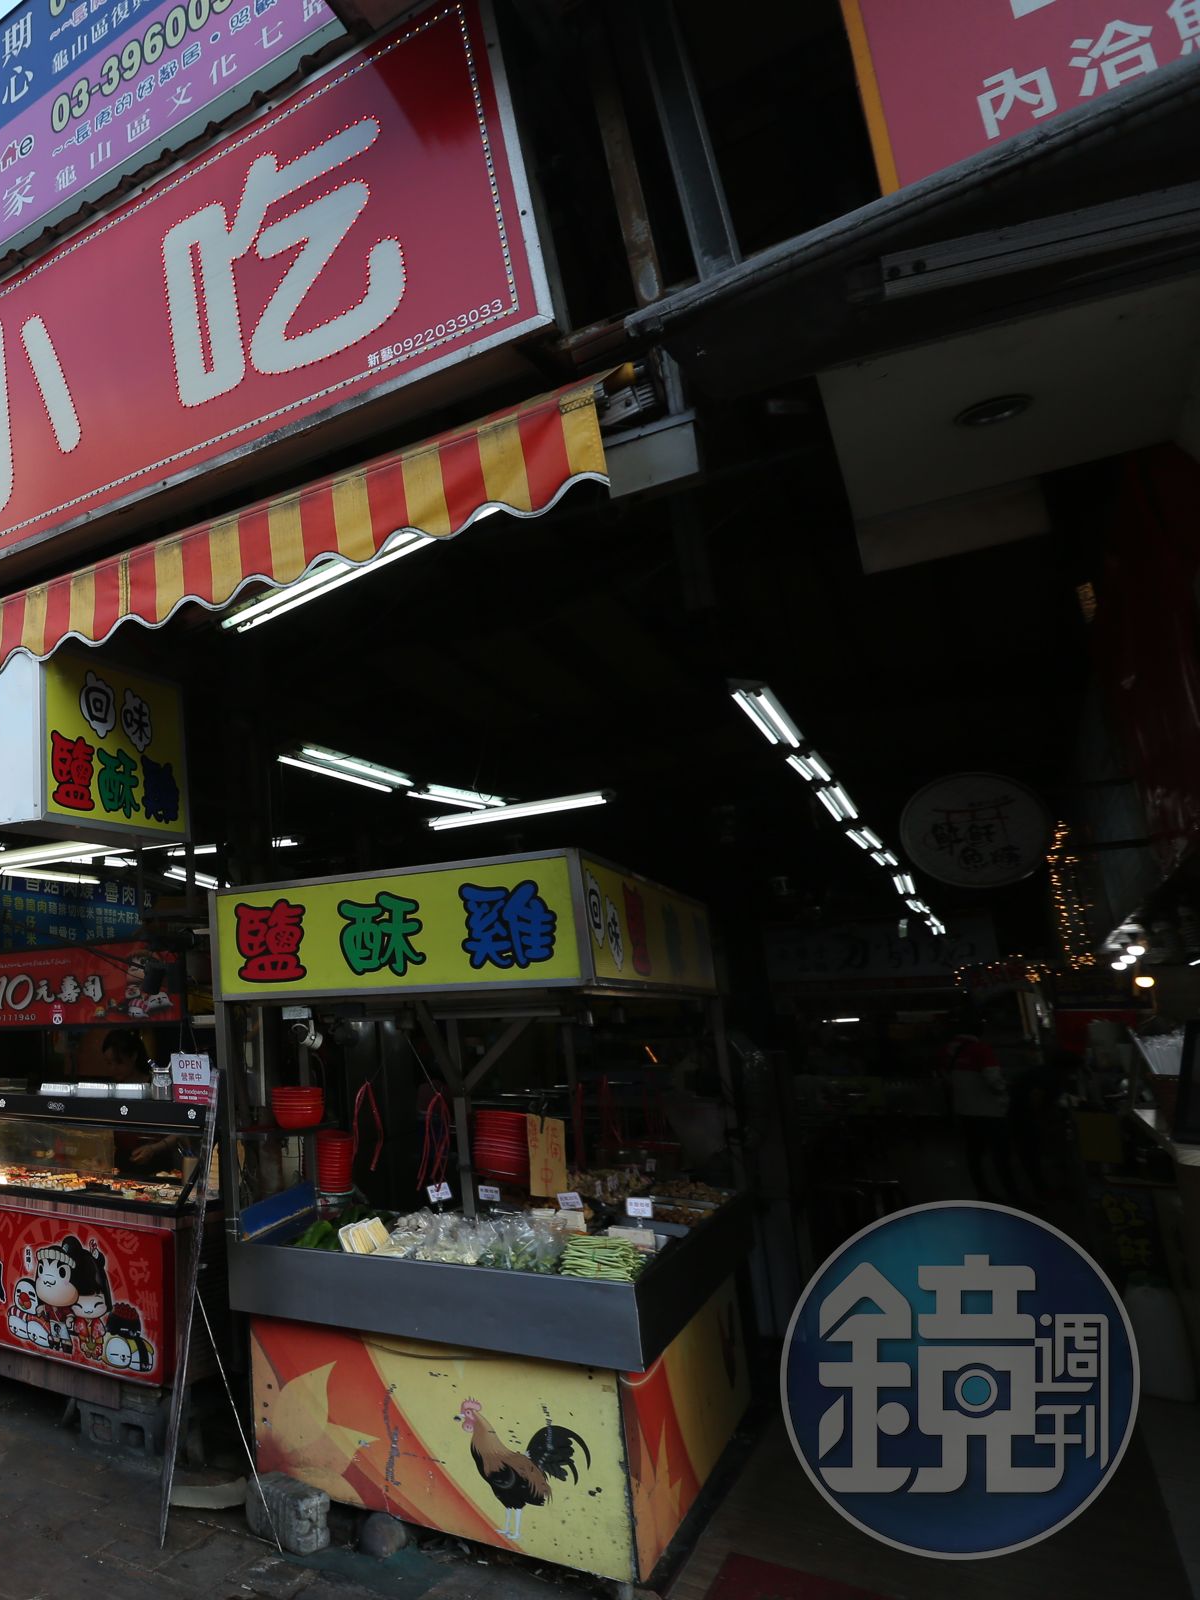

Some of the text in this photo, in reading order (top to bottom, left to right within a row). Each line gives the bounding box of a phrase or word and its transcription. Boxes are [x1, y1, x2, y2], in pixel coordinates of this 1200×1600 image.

[84, 684, 151, 743] 回味
[234, 879, 557, 984] 鹽酥雞
[178, 1059, 202, 1069] OPEN
